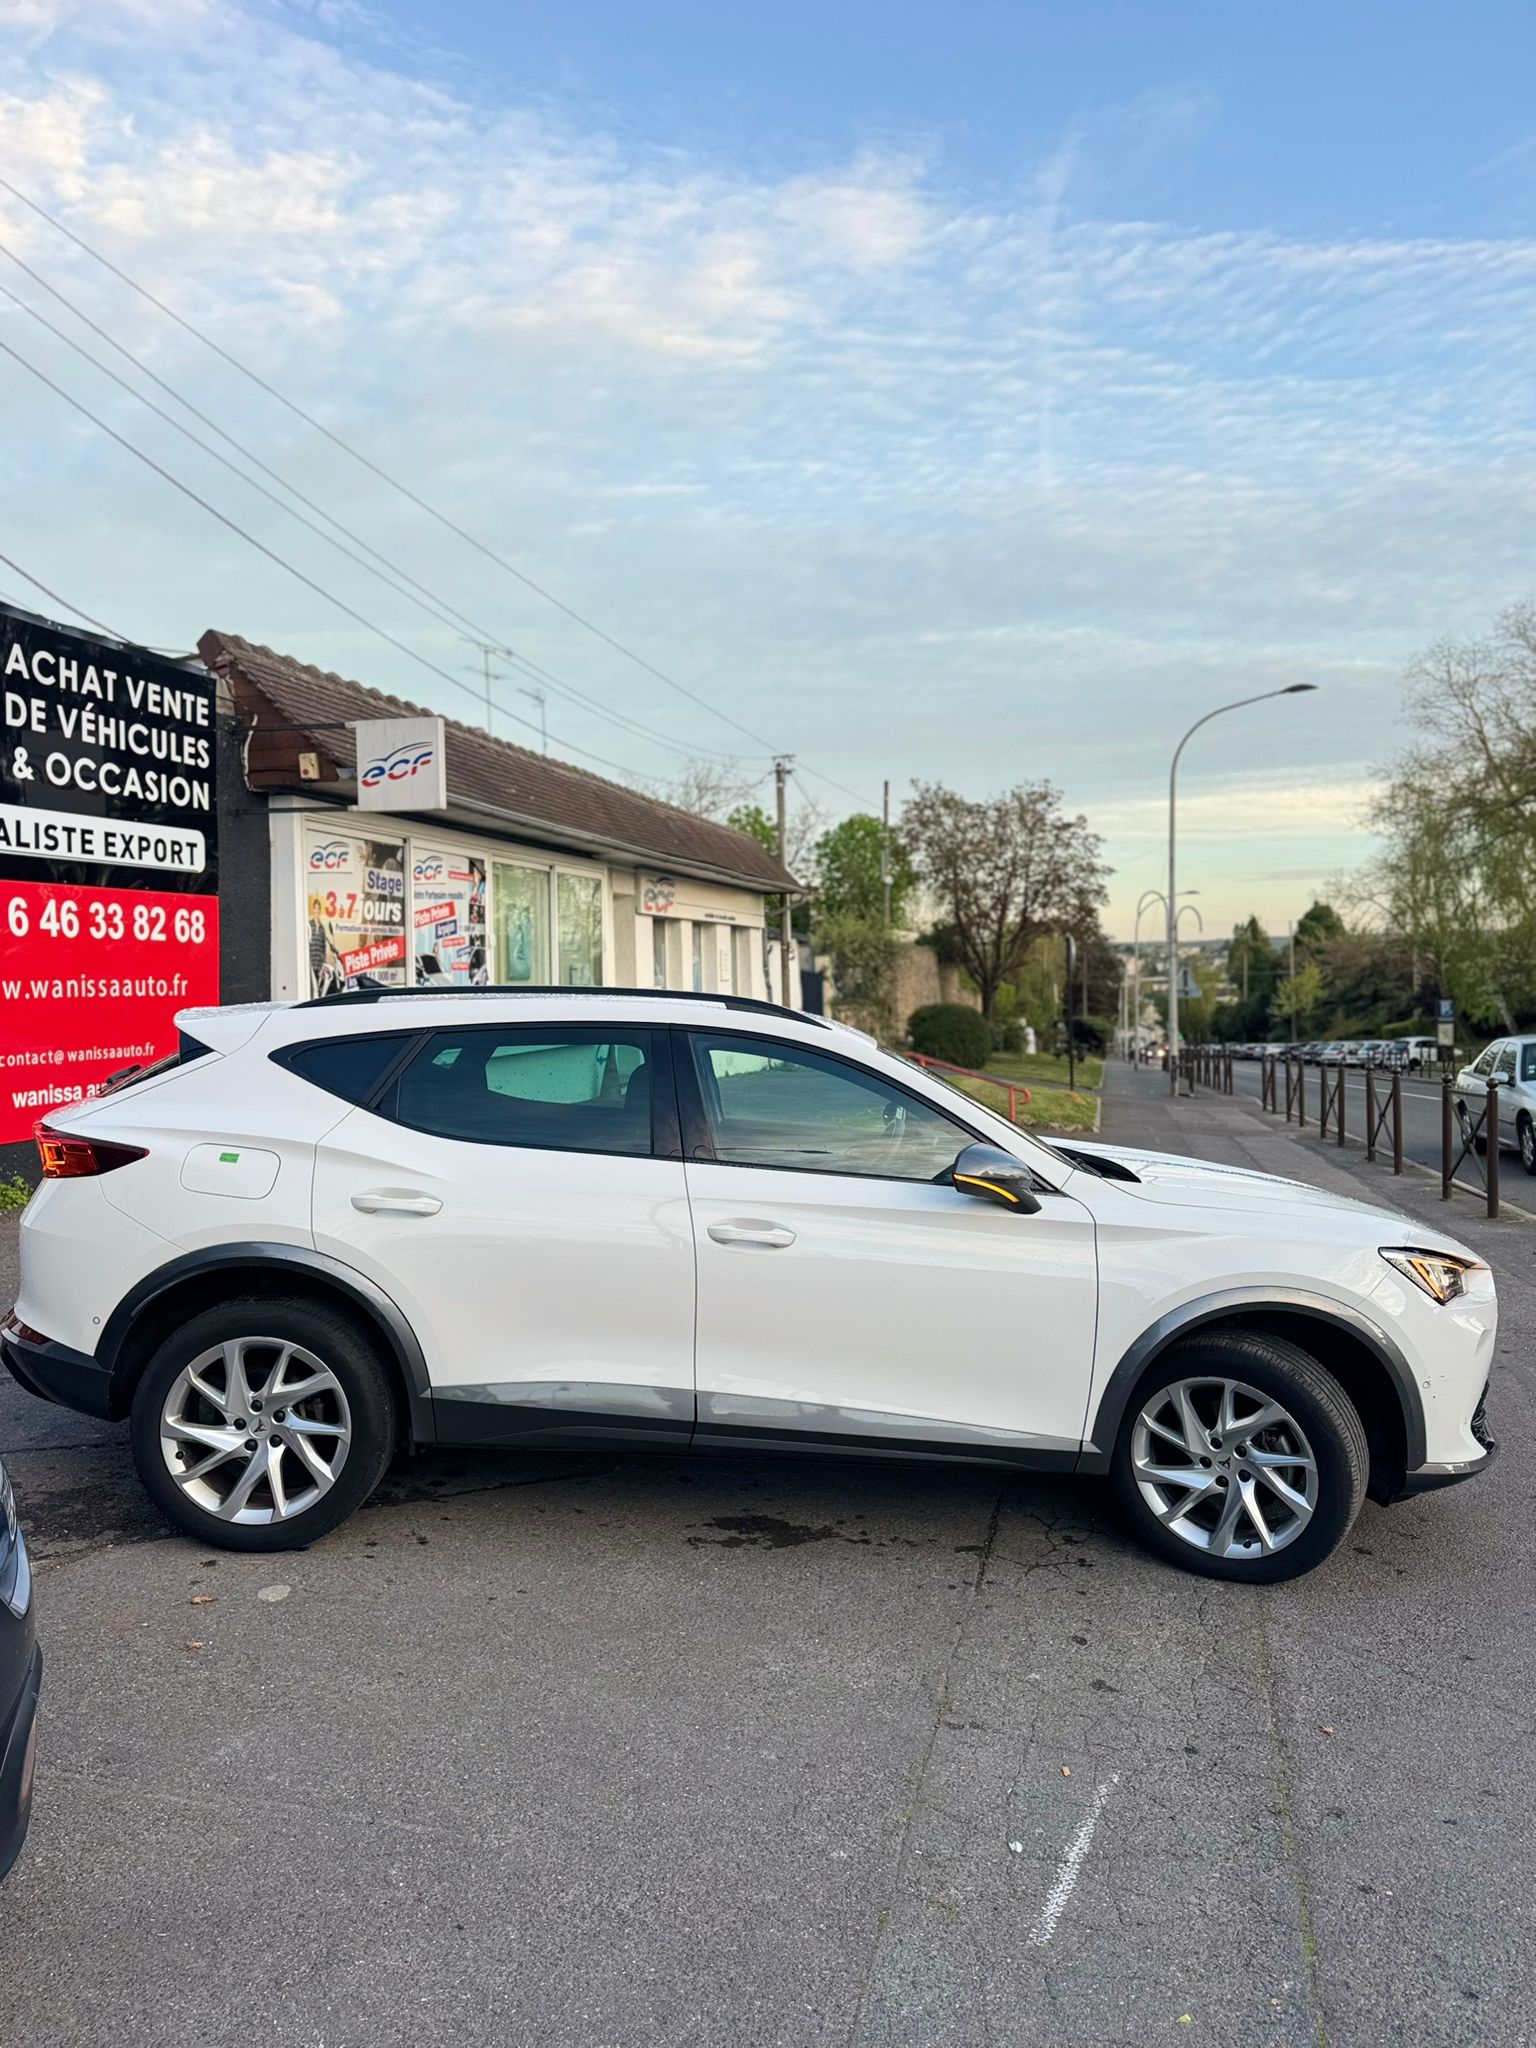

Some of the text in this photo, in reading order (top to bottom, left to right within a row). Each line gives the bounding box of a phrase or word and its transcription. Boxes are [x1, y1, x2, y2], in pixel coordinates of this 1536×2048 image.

[5, 642, 209, 727] ACHAT VENTE
[5, 691, 210, 769] DE VÉHICULES
[12, 746, 210, 811] & OCCASION
[104, 831, 198, 866] EXPORT
[367, 870, 402, 894] Stage
[8, 896, 206, 945] 6 46 33 82 68
[325, 890, 337, 918] 3
[347, 892, 357, 919] 7
[345, 941, 399, 973] Piste Privée
[2, 973, 188, 1000] w.wanissaauto.fr
[0, 1042, 156, 1068] contact@ wanissaauto.fr
[12, 1083, 83, 1108] wanissa
